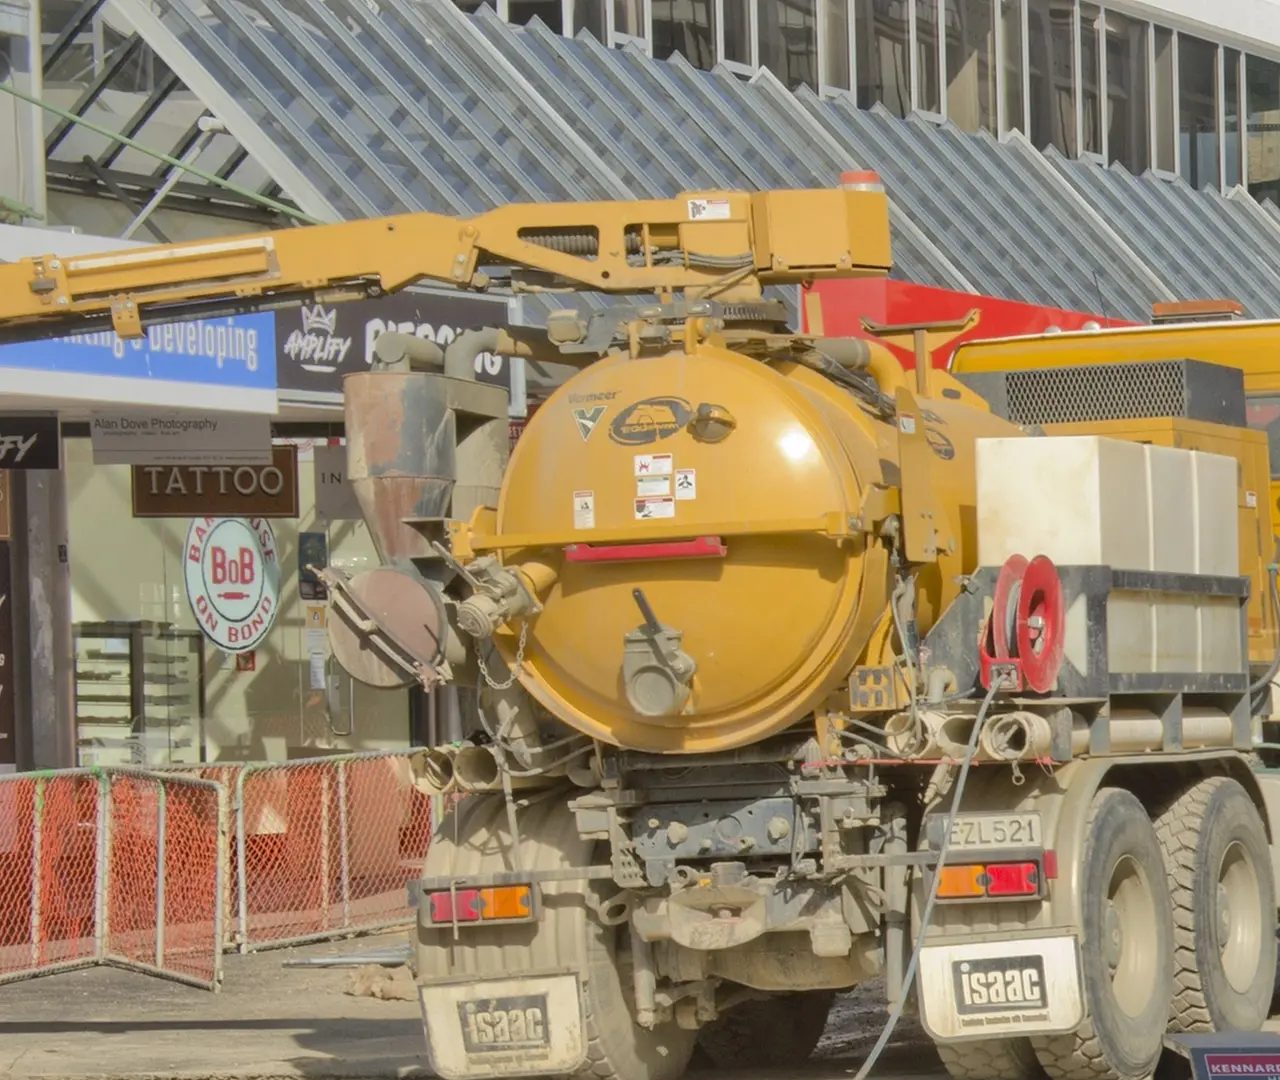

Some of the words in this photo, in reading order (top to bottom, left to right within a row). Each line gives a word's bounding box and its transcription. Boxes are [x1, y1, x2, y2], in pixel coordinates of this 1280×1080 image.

[284, 329, 352, 364] AMPLIFY
[94, 417, 118, 429] Alan
[120, 417, 148, 430] Dove
[151, 418, 218, 432] Photography
[144, 466, 284, 495] TATTOO
[196, 595, 218, 632] ON
[228, 596, 272, 643] BOND
[948, 819, 1035, 846] EZL521
[960, 962, 1041, 1005] isaac
[465, 1002, 544, 1045] isaac
